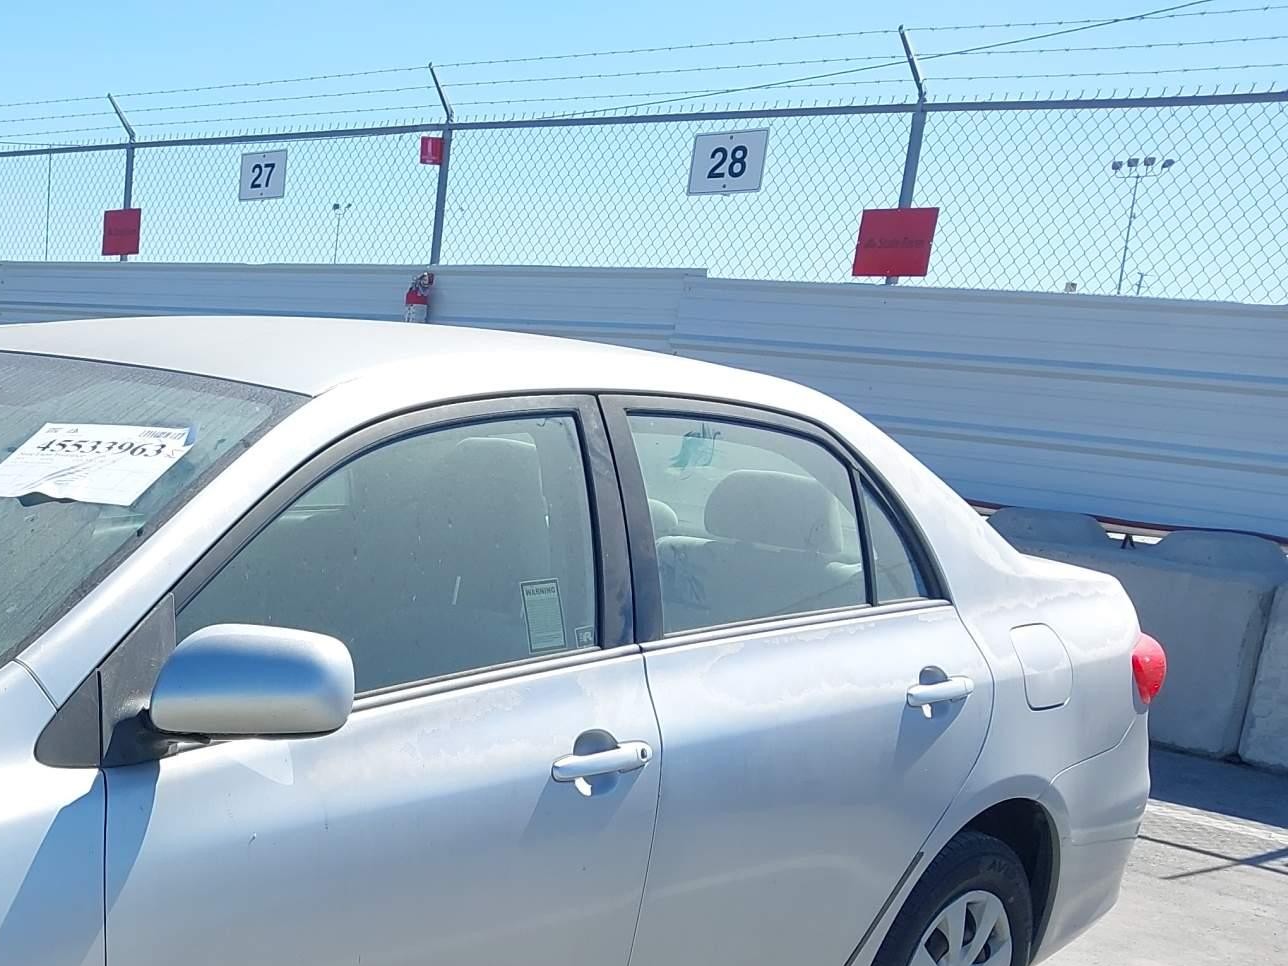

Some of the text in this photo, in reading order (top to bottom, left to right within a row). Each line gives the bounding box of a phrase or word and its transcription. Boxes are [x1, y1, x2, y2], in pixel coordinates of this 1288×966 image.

[249, 162, 276, 189] 27
[706, 145, 748, 179] 28
[36, 438, 167, 459] 45533963
